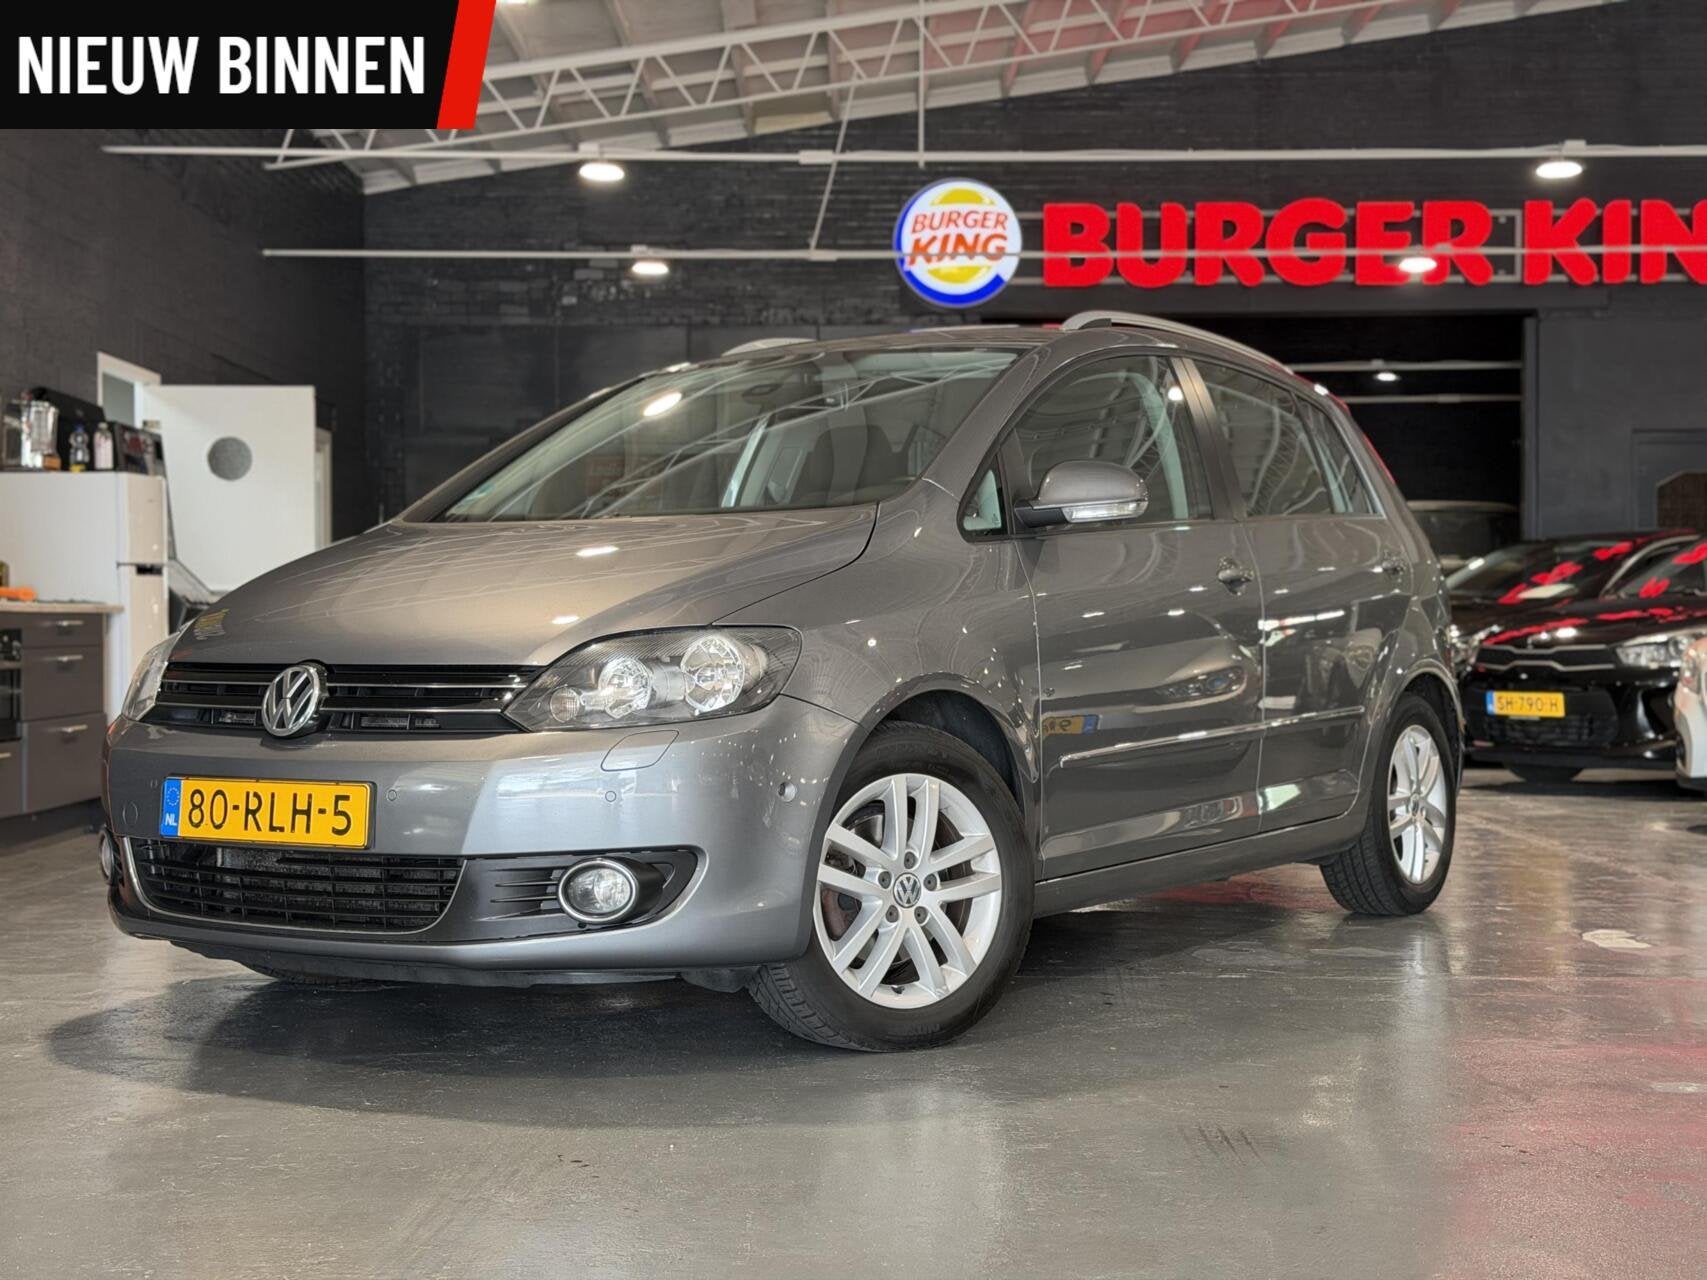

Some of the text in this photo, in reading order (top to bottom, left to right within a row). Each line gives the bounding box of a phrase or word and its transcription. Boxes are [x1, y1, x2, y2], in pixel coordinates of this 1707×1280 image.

[912, 210, 1008, 234] BURGER
[908, 233, 1007, 266] KING
[1043, 198, 1494, 288] BURGER
[164, 813, 178, 827] NL
[188, 789, 352, 836] 80-RLH-5
